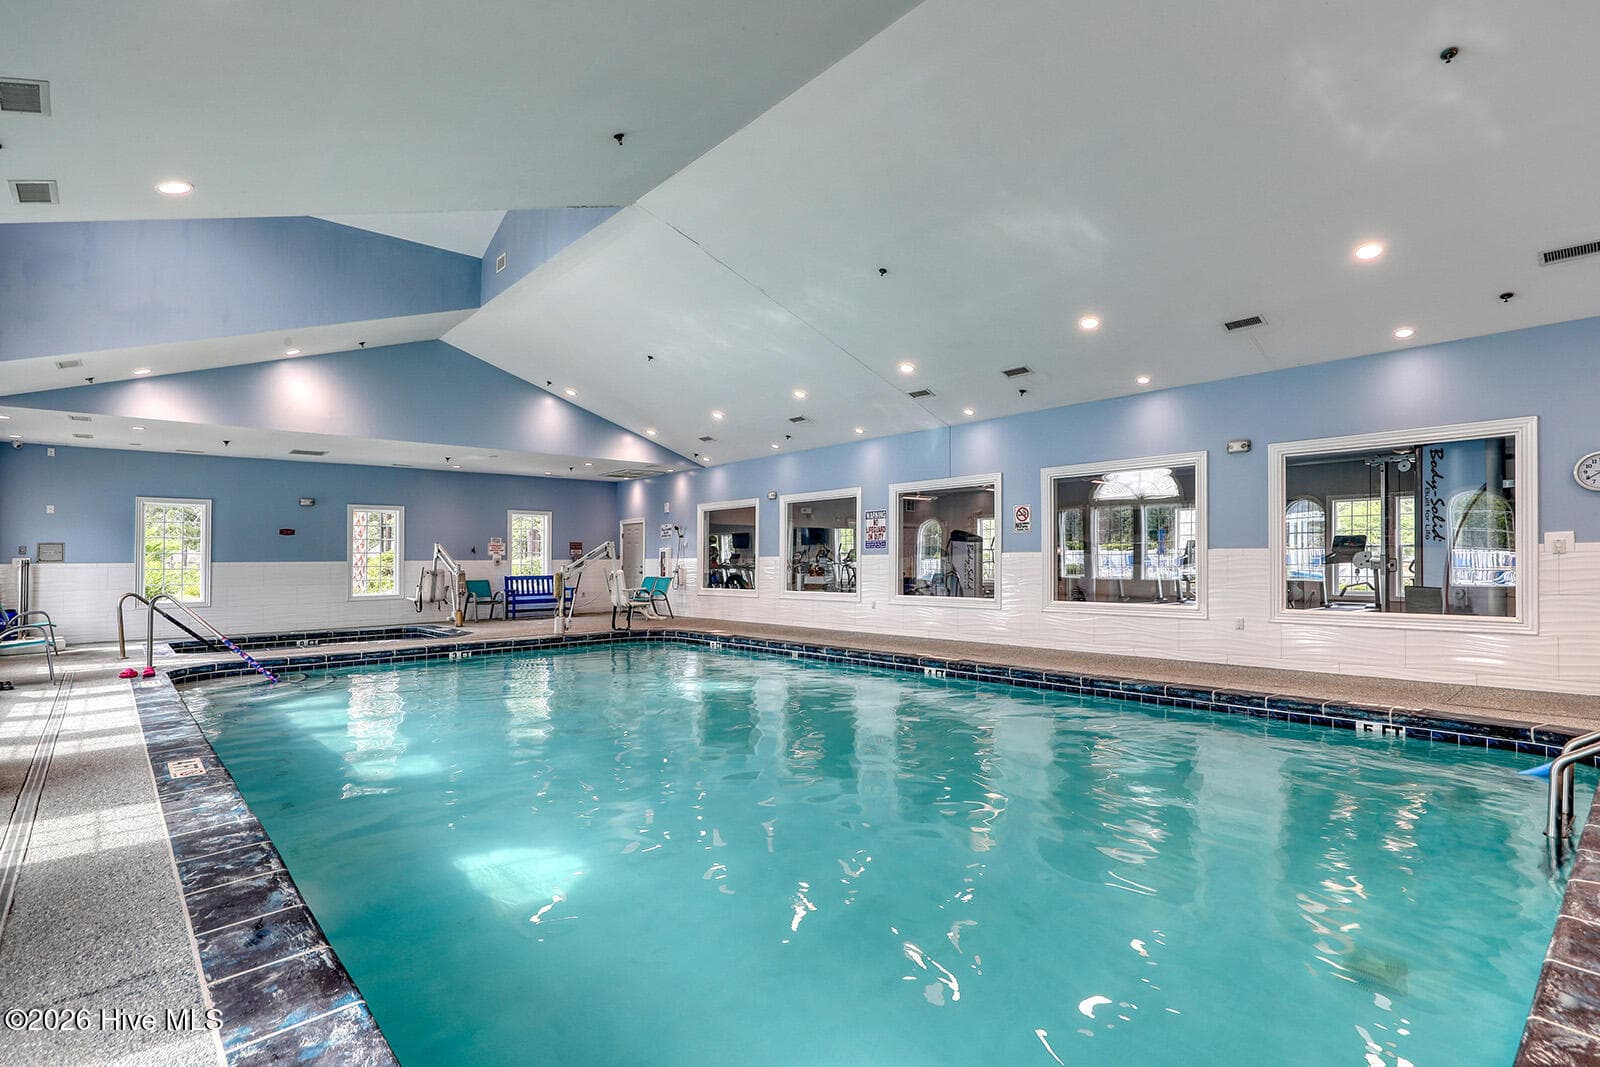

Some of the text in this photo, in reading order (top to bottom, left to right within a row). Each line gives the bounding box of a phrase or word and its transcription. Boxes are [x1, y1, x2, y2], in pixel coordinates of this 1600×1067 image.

[1426, 448, 1445, 542] Body-Solid
[866, 525, 886, 533] LIFEGUARD
[1381, 724, 1404, 737] FT
